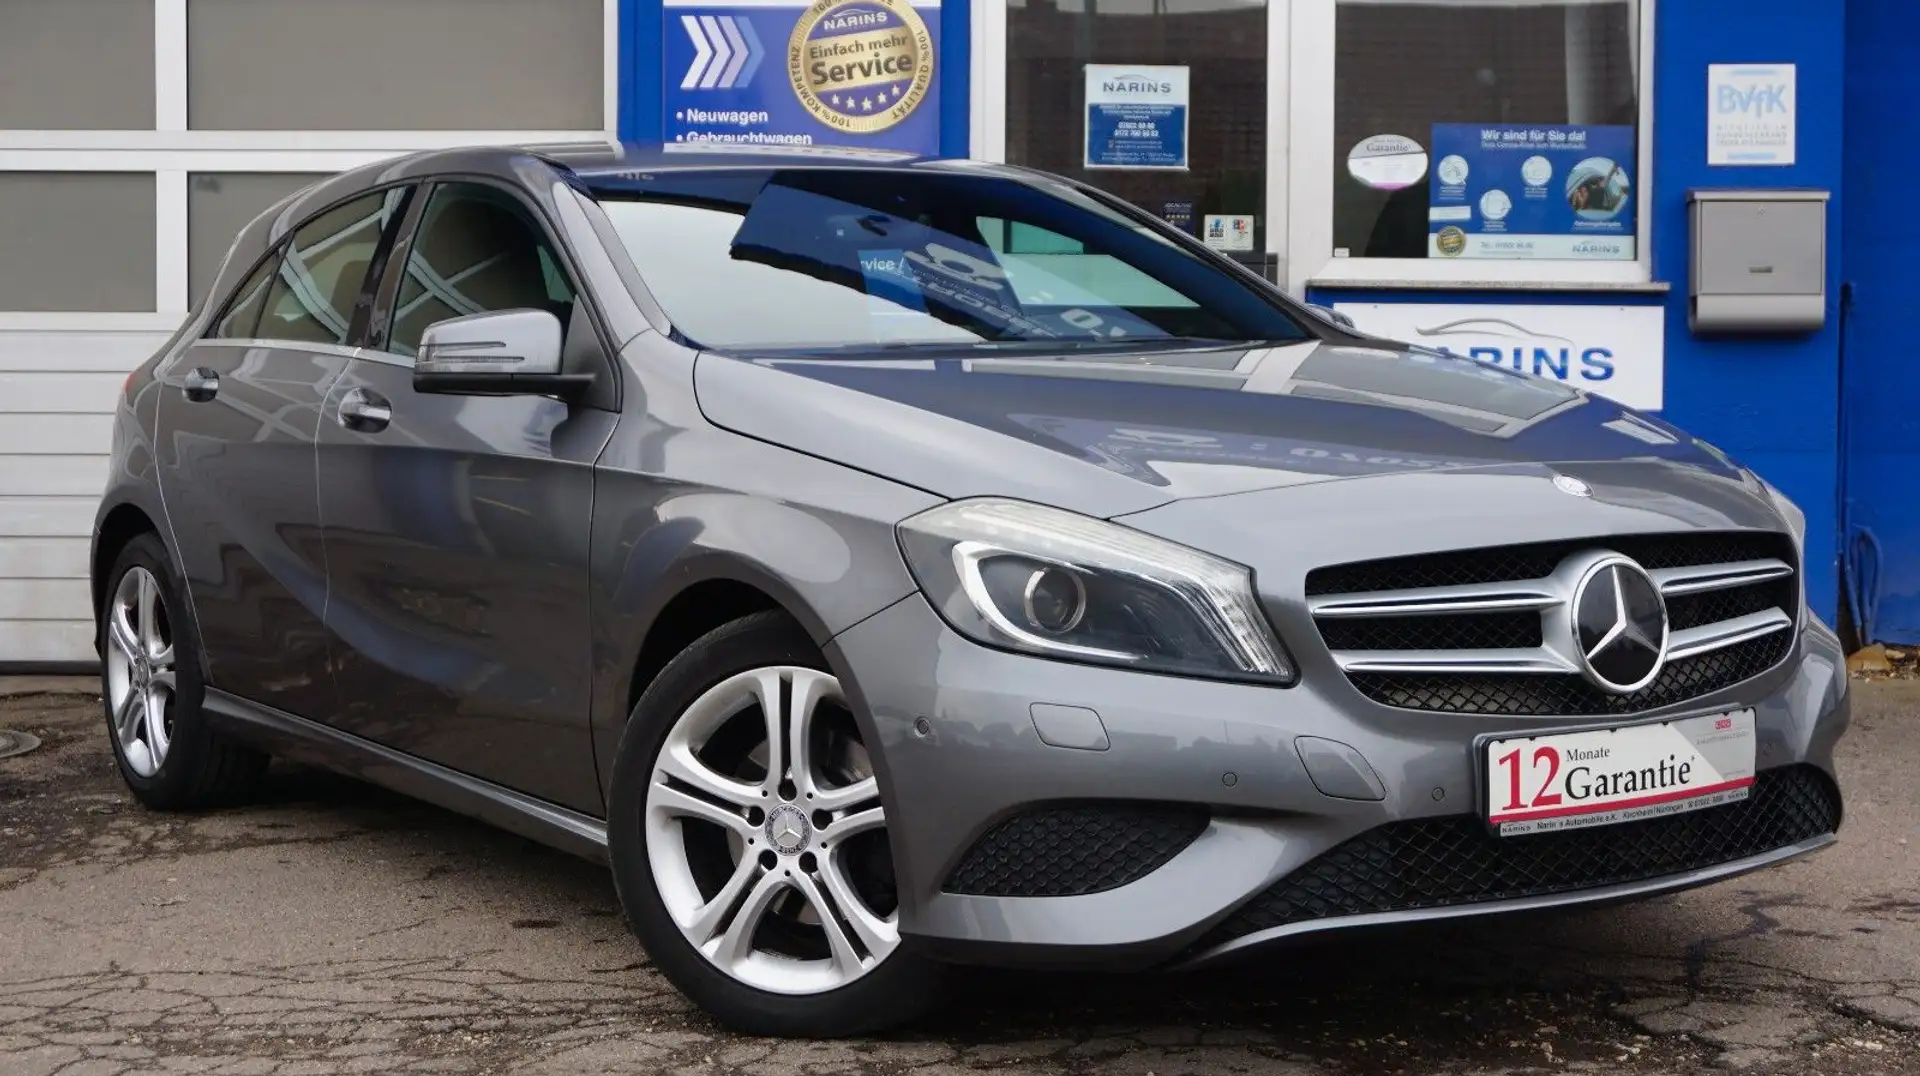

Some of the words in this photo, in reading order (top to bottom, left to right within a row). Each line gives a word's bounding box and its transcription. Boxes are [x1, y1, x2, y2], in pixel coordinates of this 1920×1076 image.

[823, 11, 888, 31] NARINS
[810, 39, 864, 59] Einfach
[868, 35, 907, 50] mehr
[811, 52, 912, 85] Service
[1103, 82, 1172, 93] NARINS
[686, 109, 768, 124] Neuwagen
[686, 131, 813, 145] Gebrauchtwagen
[1482, 129, 1500, 140] Wir
[1503, 129, 1527, 140] sind
[1529, 129, 1546, 140] für
[1548, 130, 1566, 140] Sie
[1568, 130, 1586, 141] da!
[1572, 244, 1620, 254] NARINS
[1566, 747, 1610, 762] Monate
[1499, 746, 1562, 811] 12
